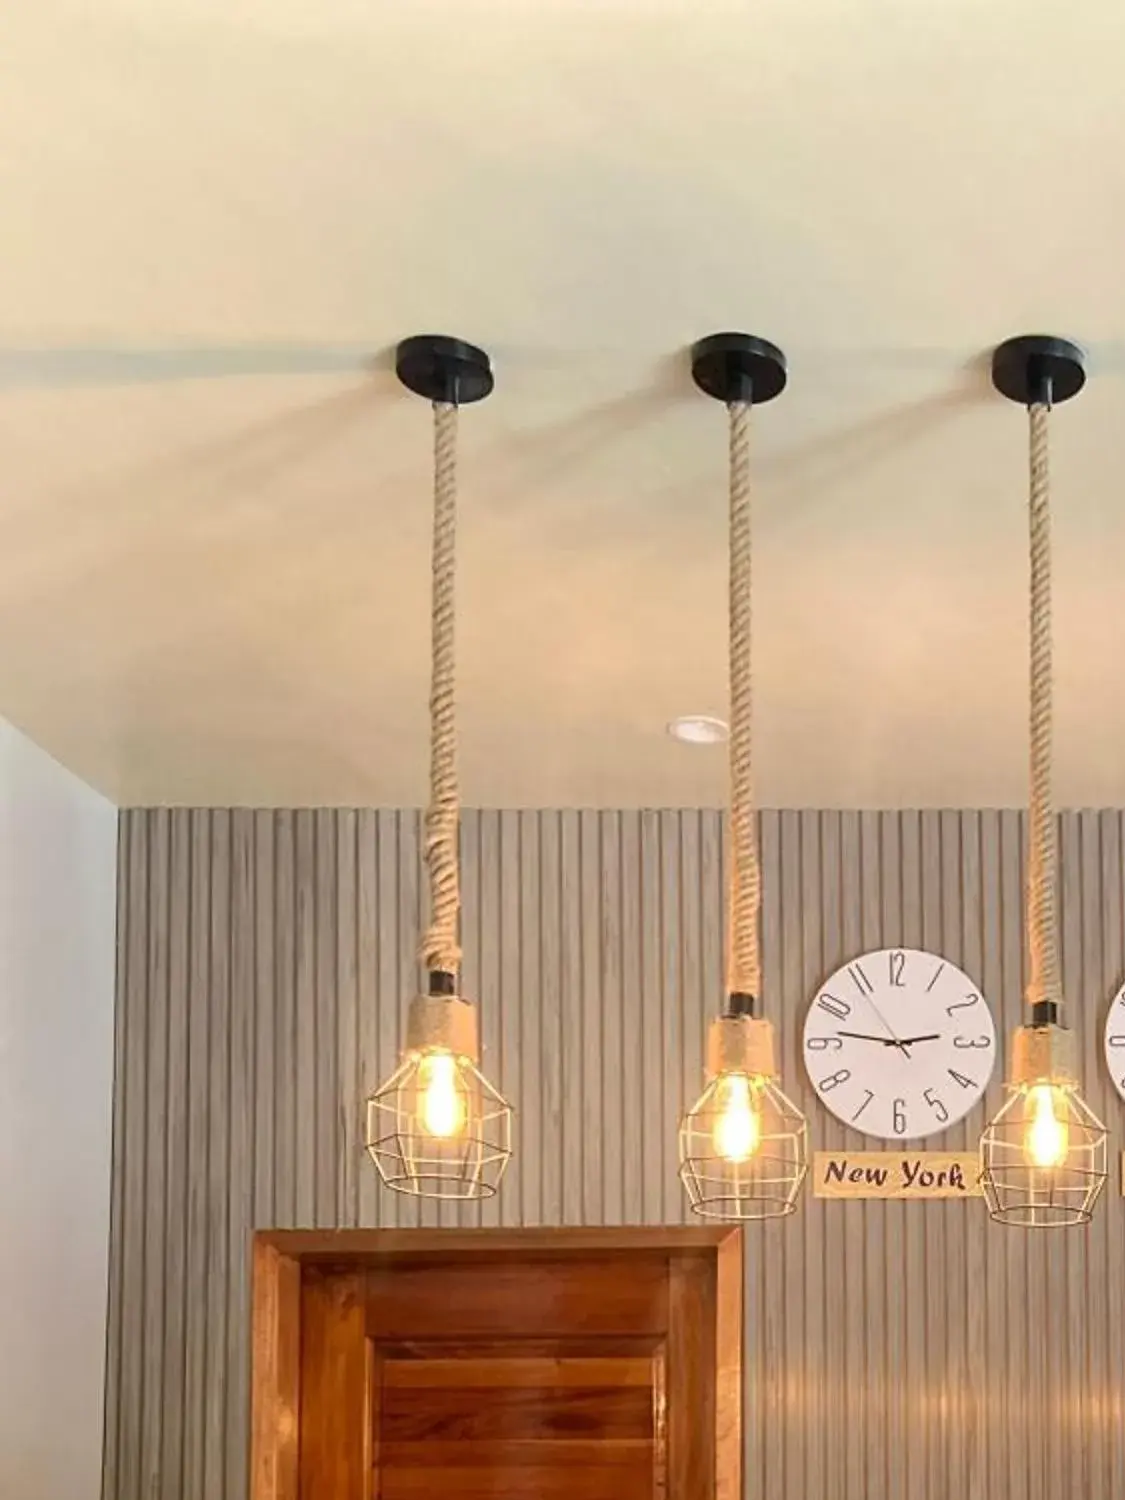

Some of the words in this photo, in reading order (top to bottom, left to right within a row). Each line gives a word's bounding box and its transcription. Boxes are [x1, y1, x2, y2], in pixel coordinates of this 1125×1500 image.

[848, 964, 874, 995] 11
[890, 952, 905, 986] 12
[818, 993, 851, 1021] 10
[946, 993, 979, 1017] 2
[808, 1037, 842, 1049] 9
[953, 1035, 991, 1049] 3
[819, 1070, 851, 1092] 8
[948, 1069, 979, 1088] 4
[852, 1090, 874, 1121] 7
[893, 1099, 905, 1134] 6
[924, 1088, 948, 1123] 5
[824, 1160, 888, 1187] New
[901, 1160, 966, 1190] York
